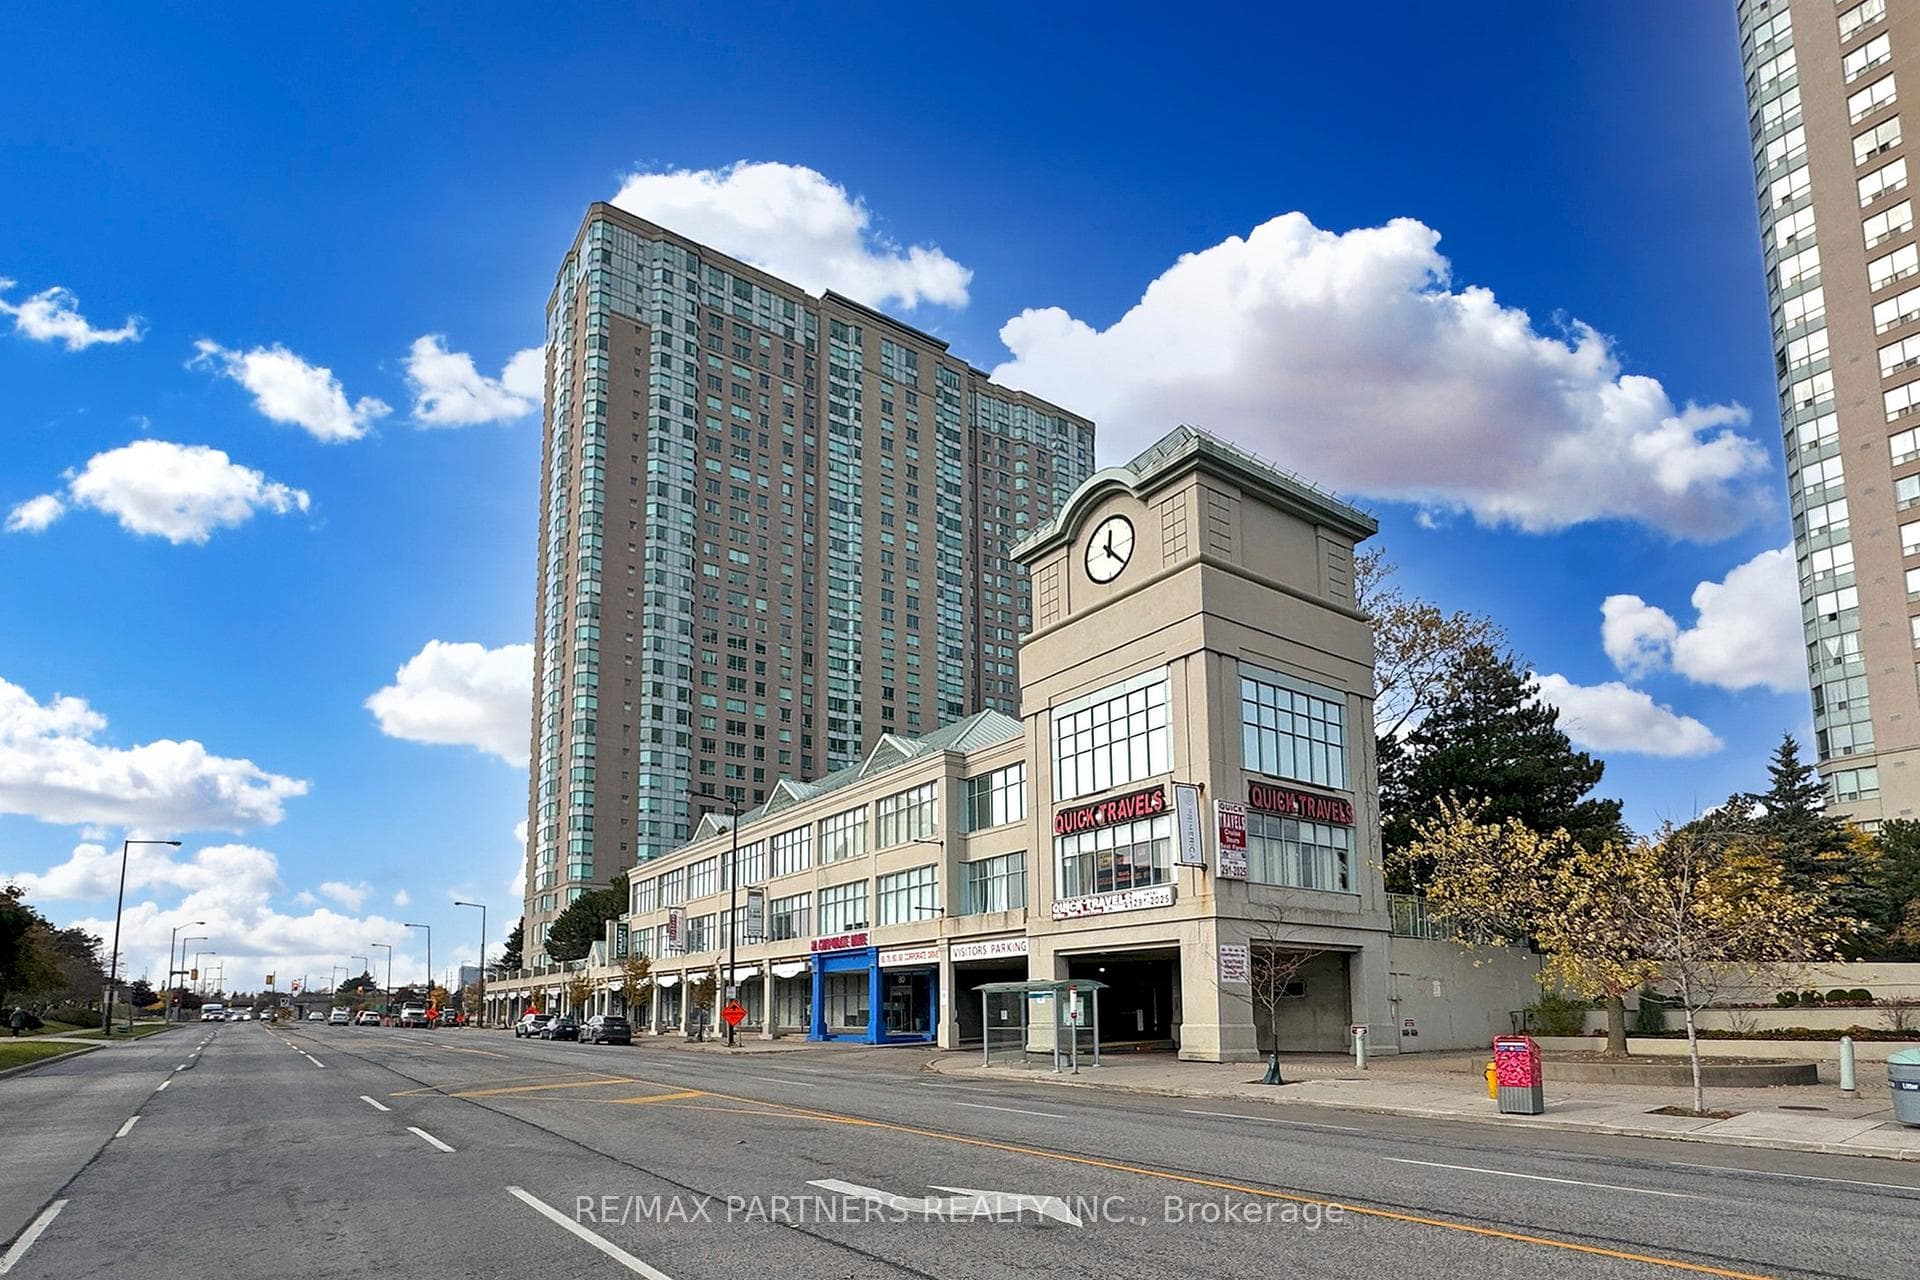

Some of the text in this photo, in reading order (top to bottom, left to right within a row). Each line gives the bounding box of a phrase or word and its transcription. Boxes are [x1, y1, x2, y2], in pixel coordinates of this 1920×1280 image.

[1054, 790, 1164, 834] QUICK TRAVELS
[1219, 802, 1244, 814] QUICK
[1252, 785, 1354, 824] QUICK TRAVELS
[1219, 811, 1247, 832] TRAVELS
[1052, 899, 1083, 915] QUICK
[1086, 892, 1133, 911] TRAVELS
[953, 945, 987, 958] VISITORS
[991, 941, 1027, 955] PARKING
